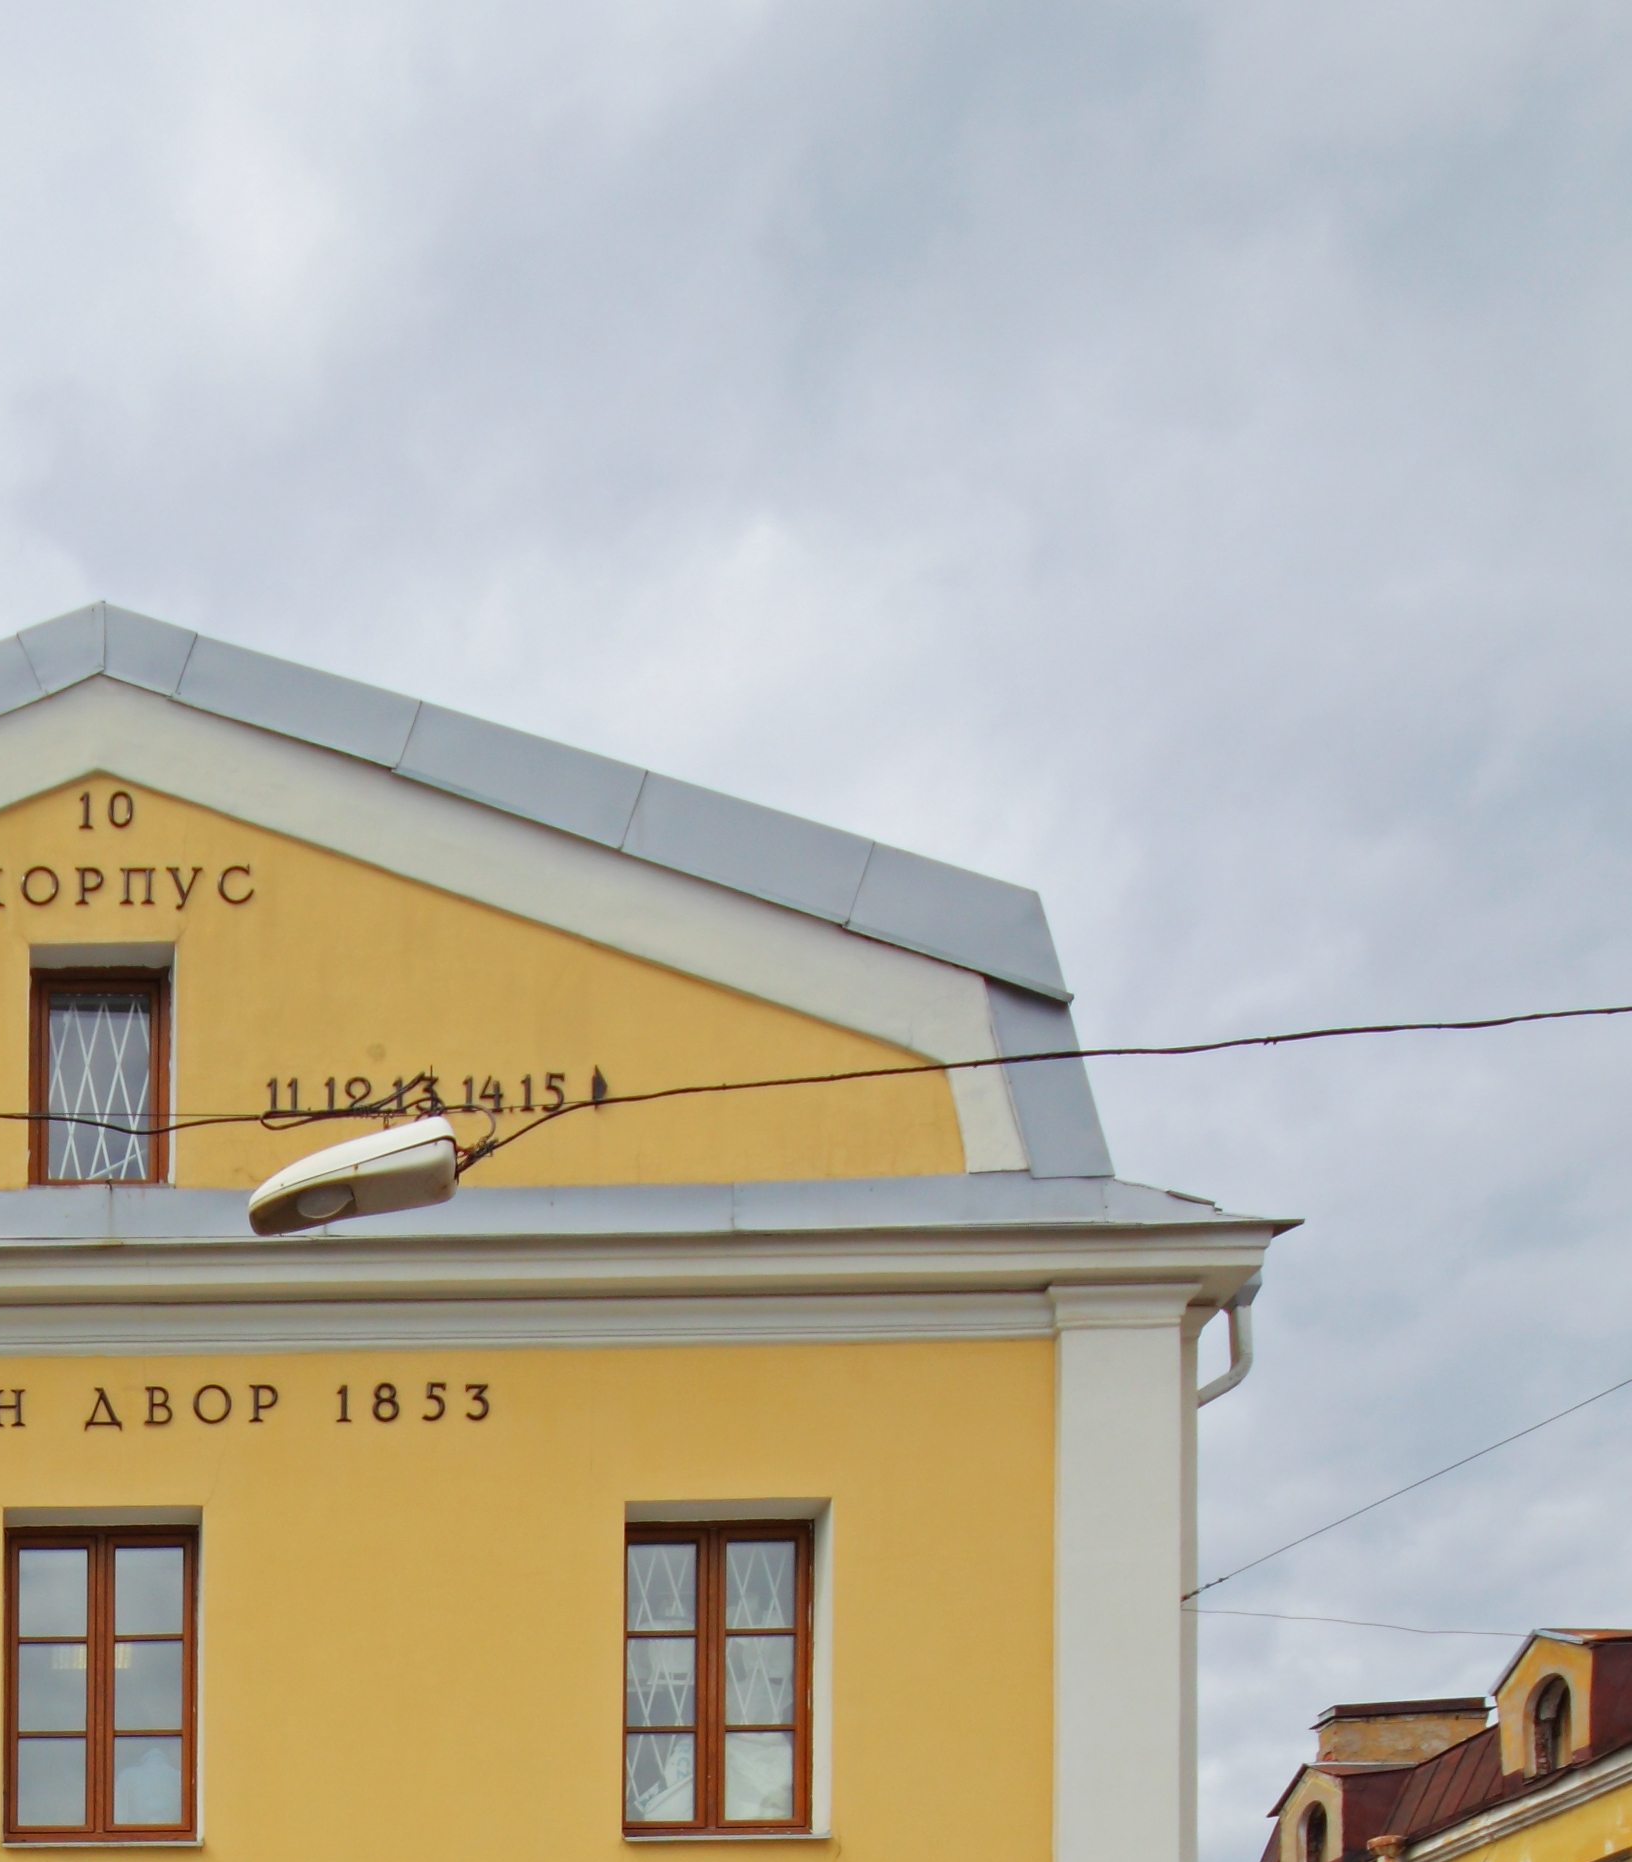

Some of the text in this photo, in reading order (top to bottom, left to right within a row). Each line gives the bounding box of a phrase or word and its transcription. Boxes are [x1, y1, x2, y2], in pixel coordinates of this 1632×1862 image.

[79, 790, 134, 829] 10
[84, 1384, 279, 1431] ДВОР
[336, 1382, 490, 1423] 1853
